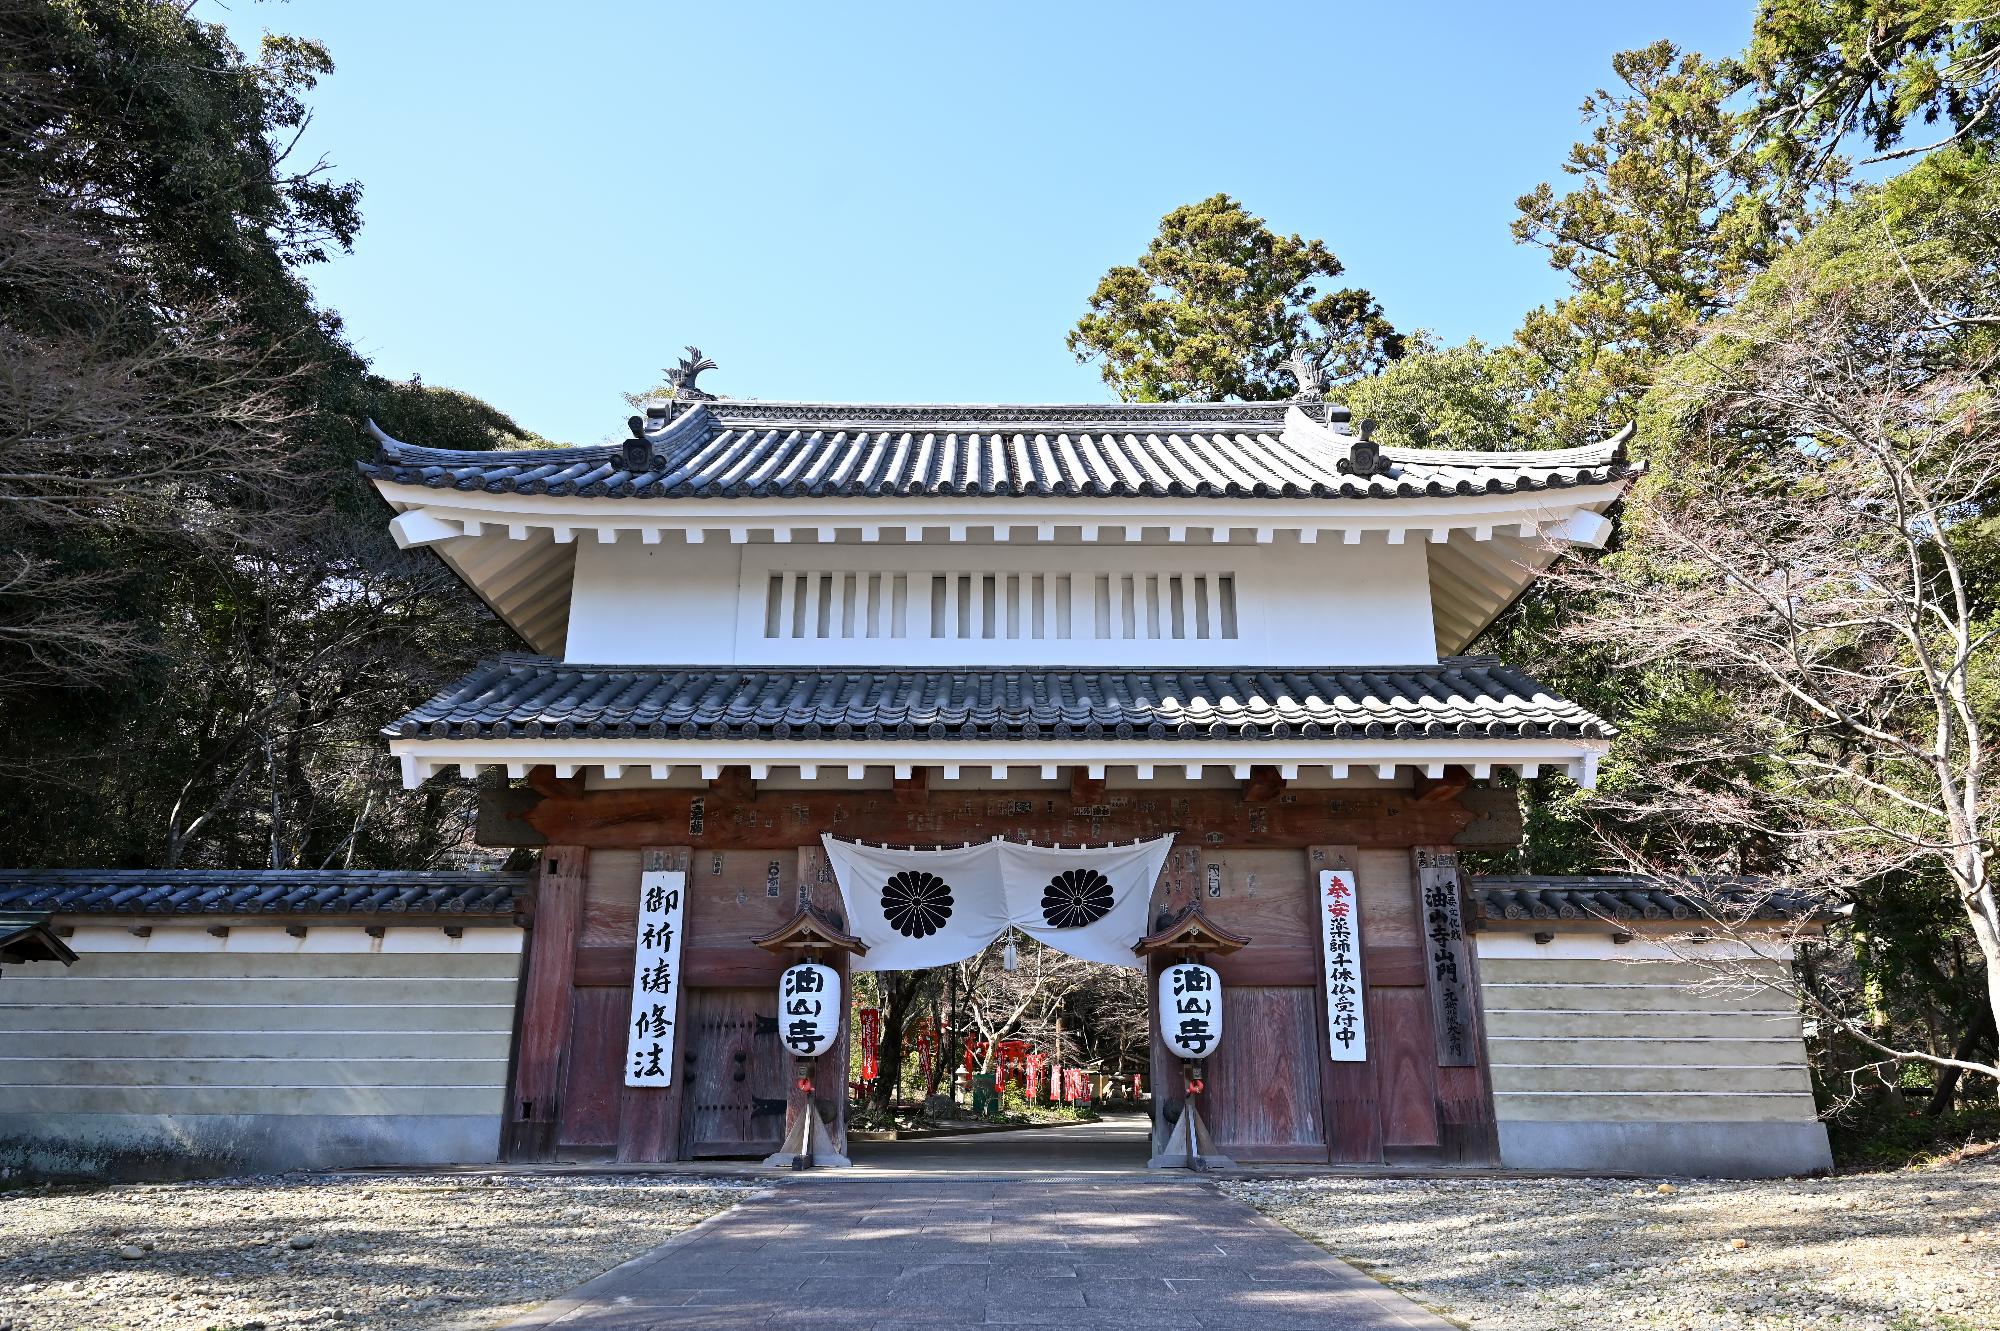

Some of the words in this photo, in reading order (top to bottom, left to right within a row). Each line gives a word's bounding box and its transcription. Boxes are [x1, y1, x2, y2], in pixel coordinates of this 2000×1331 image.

[634, 886, 679, 1078] 御祈祷修法
[785, 966, 826, 1054] 油山寺
[1173, 966, 1215, 1054] 油山寺
